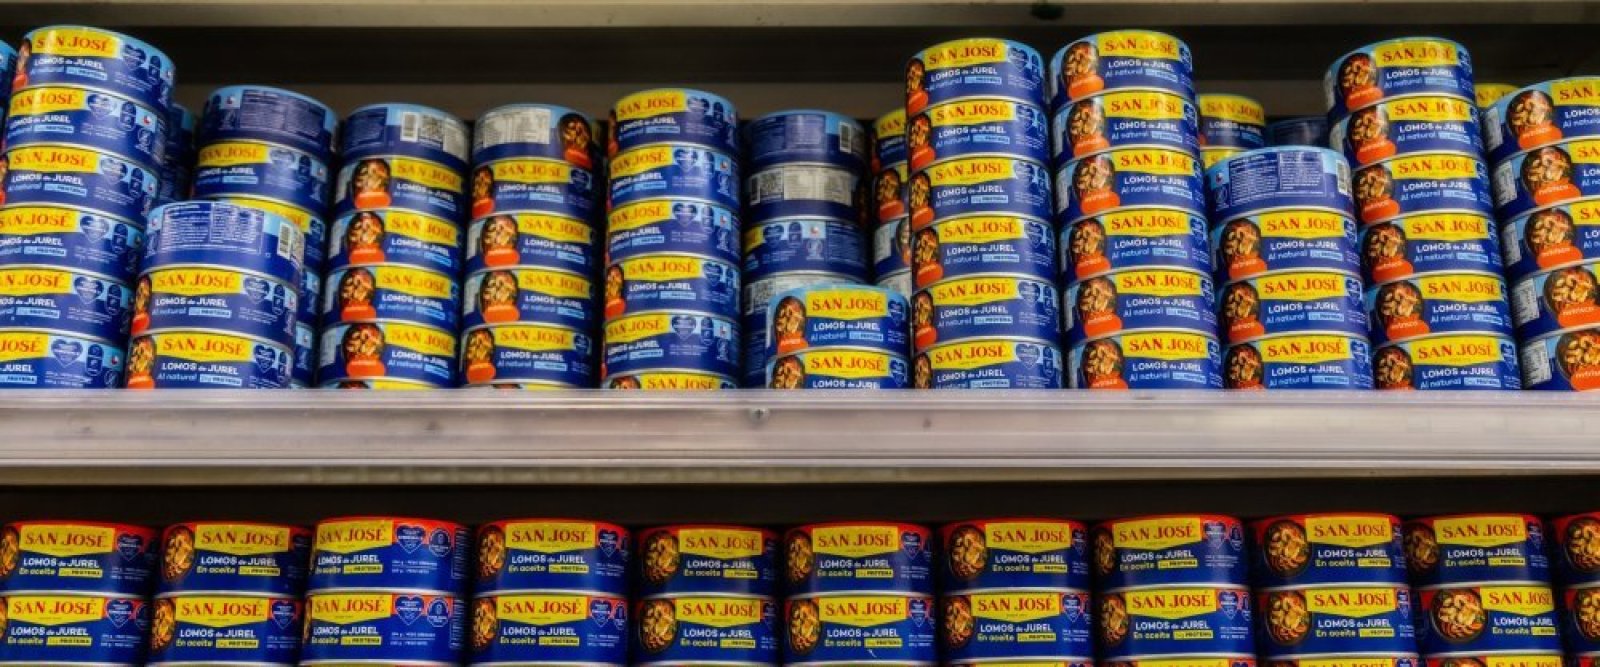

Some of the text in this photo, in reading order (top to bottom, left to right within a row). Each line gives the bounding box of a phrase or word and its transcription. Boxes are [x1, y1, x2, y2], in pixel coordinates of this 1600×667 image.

[929, 48, 959, 62] SAN
[1559, 86, 1591, 100] SAN
[936, 166, 963, 179] SAN
[937, 187, 966, 198] LOMOS
[1111, 216, 1143, 229] SAN
[1267, 219, 1301, 232] SAN
[944, 223, 974, 236] SAN
[946, 246, 978, 256] LOMOS
[989, 244, 1015, 252] JUREL
[1115, 239, 1147, 248] LOMOS
[1158, 240, 1184, 248] JUREL
[1270, 241, 1305, 251] LOMOS
[1315, 241, 1340, 250] JUREL
[157, 272, 187, 286] SAN
[1122, 276, 1156, 289] SAN
[937, 286, 969, 299] SAN
[1263, 281, 1298, 294] SAN
[1428, 282, 1459, 294] SAN
[812, 298, 842, 311] SAN
[814, 322, 845, 331] LOMOS
[856, 322, 880, 331] JUREL
[164, 336, 196, 350] SAN
[1129, 339, 1163, 352] SAN
[1267, 342, 1303, 357] SAN
[935, 350, 963, 363] SAN
[1417, 345, 1452, 358] SAN
[811, 356, 842, 368] SAN
[1132, 362, 1168, 372] LOMOS
[1178, 363, 1202, 373] JUREL
[162, 362, 197, 371] LOMOS
[208, 364, 239, 376] JUREL
[1271, 366, 1307, 377] LOMOS
[1317, 366, 1344, 374] JUREL
[511, 529, 542, 542] SAN
[993, 530, 1026, 542] SAN
[1119, 527, 1149, 541] SAN
[1314, 524, 1349, 537] SAN
[1442, 526, 1478, 539] SAN
[25, 532, 57, 545] SAN
[818, 534, 850, 548] SAN
[511, 555, 546, 564] LOMOS
[556, 555, 586, 564] JUREL
[1318, 549, 1354, 558] LOMOS
[1364, 549, 1388, 557] JUREL
[23, 558, 56, 566] LOMOS
[68, 559, 99, 568] JUREL
[694, 569, 721, 577] aceite
[315, 600, 343, 613] SAN
[503, 601, 534, 613] SAN
[978, 598, 1009, 611] SAN
[1132, 596, 1165, 609] SAN
[1314, 594, 1350, 607] SAN
[13, 601, 46, 614] SAN
[181, 603, 213, 616] SAN
[826, 602, 858, 616] SAN
[180, 629, 214, 638] LOMOS
[224, 630, 256, 638] JUREL
[503, 626, 536, 636] LOMOS
[547, 627, 576, 636] JUREL
[827, 629, 860, 638] LOMOS
[871, 629, 899, 638] JUREL
[980, 624, 1014, 632] LOMOS
[1024, 623, 1053, 632] JUREL
[509, 636, 536, 644] aceite
